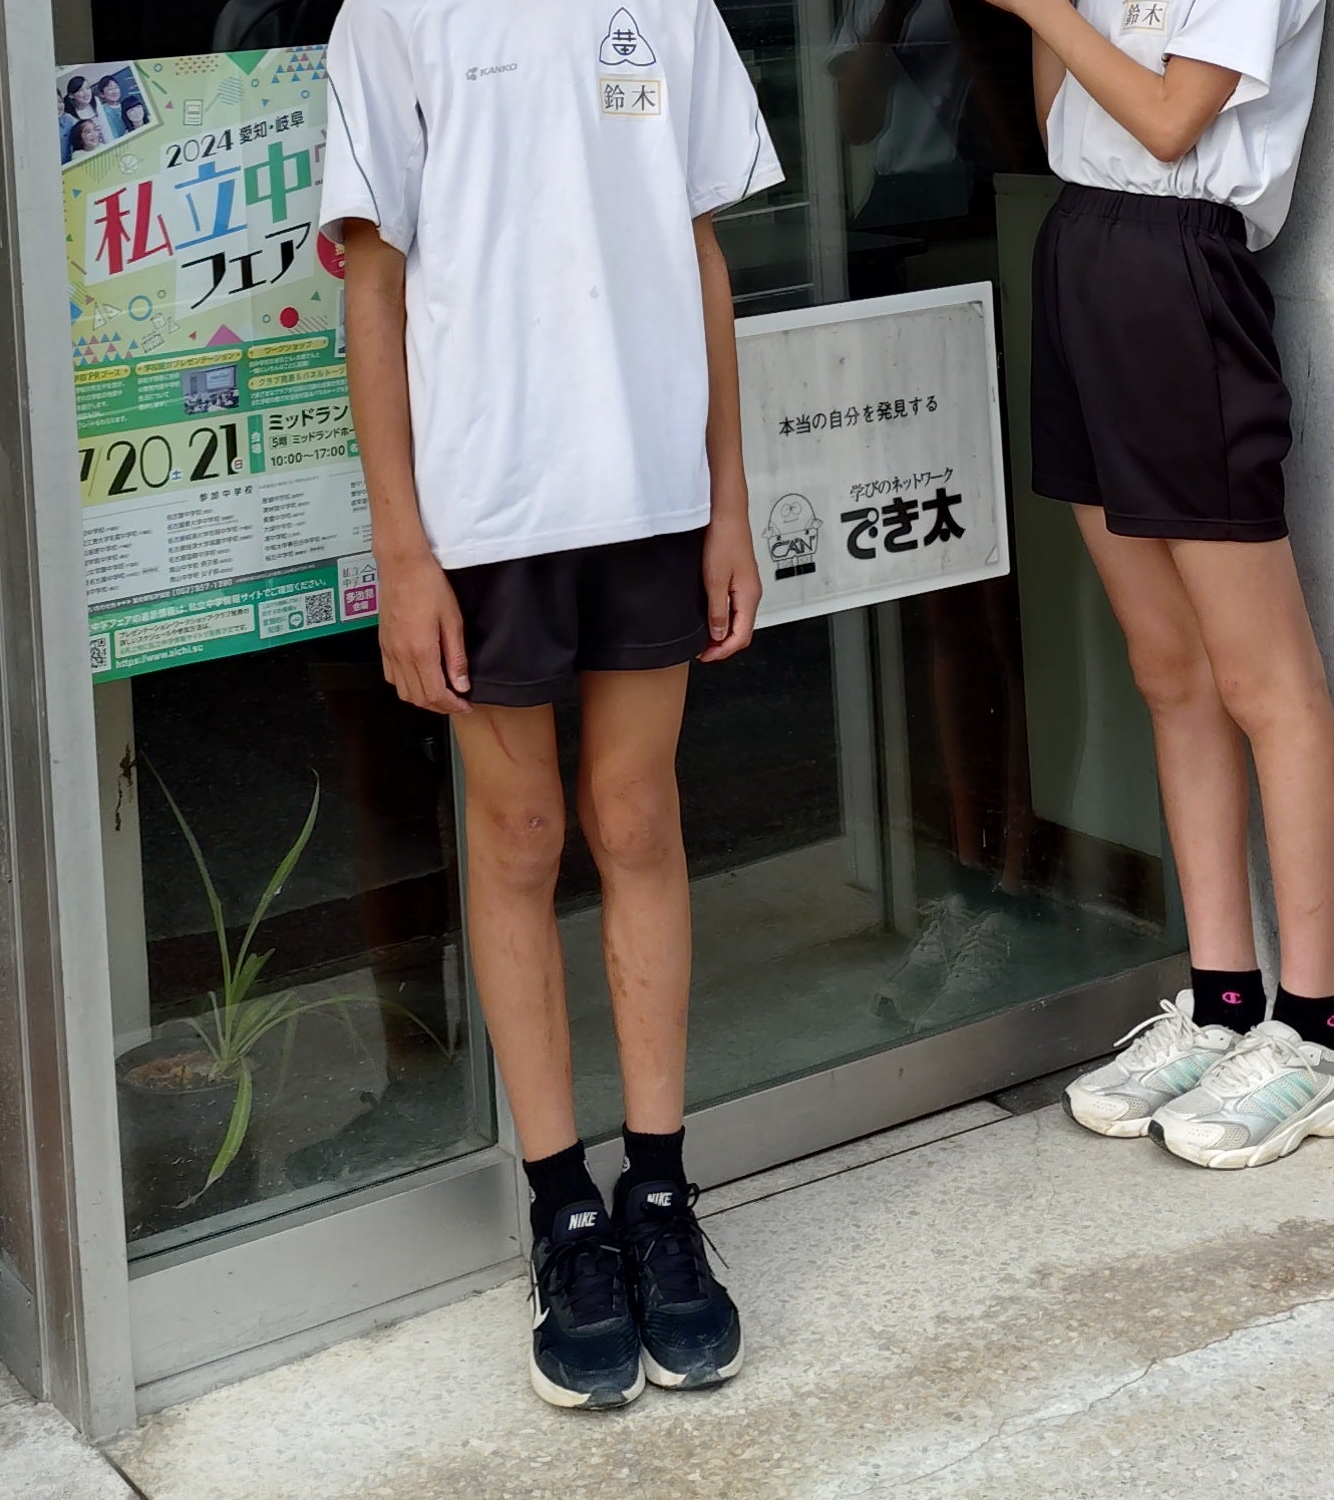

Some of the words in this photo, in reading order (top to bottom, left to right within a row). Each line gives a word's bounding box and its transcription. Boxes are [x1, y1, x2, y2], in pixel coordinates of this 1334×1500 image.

[1125, 3, 1163, 25] 鈴木
[604, 83, 656, 111] 鈴木
[166, 128, 234, 169] 2024
[94, 129, 327, 276] 私立中
[181, 221, 312, 310] フェア
[778, 395, 938, 437] 本当の自分を発見する
[849, 467, 954, 503] 学びのネットワーク
[840, 487, 967, 560] でき太
[647, 1191, 673, 1207] NIKE
[568, 1211, 598, 1231] NIKE
